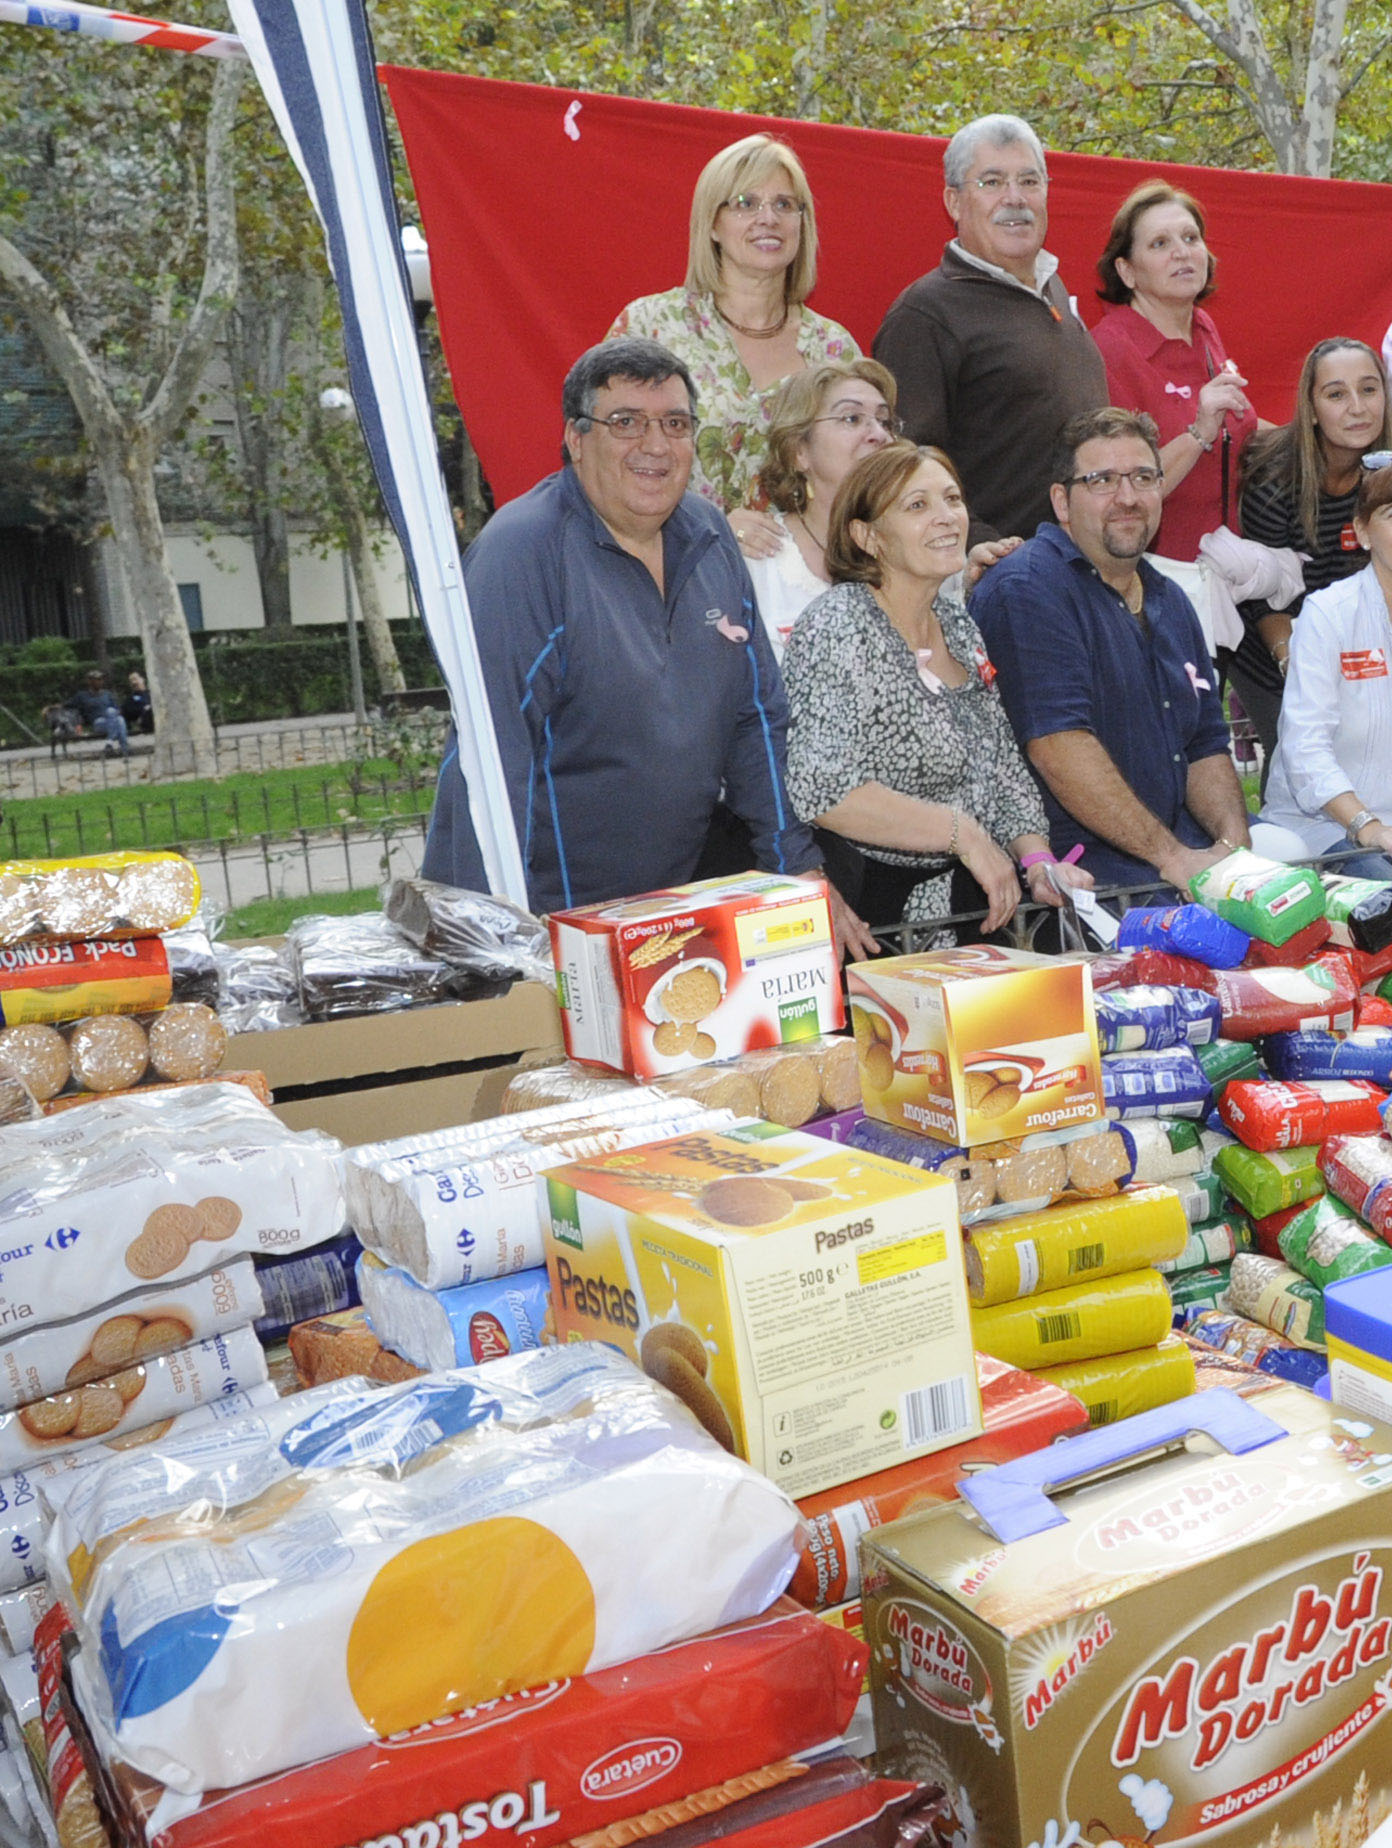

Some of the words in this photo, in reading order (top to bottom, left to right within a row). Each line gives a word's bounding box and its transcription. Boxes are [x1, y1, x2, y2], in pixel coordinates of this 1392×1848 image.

[0, 942, 75, 973] ECONÓ
[84, 939, 138, 962] Pack
[761, 966, 829, 1003] María
[779, 998, 818, 1022] gullón
[902, 1103, 958, 1138] Carrefour
[1026, 1103, 1098, 1127] Carrefour
[658, 1136, 781, 1175] Pastas
[553, 1218, 583, 1243] gullón
[815, 1217, 875, 1255] Pastas
[0, 1243, 34, 1264] our
[641, 1239, 668, 1259] RECETA
[668, 1250, 714, 1278] TRADICIONAL
[557, 1256, 641, 1332] Pastas
[799, 1268, 824, 1288] 500
[0, 1302, 34, 1327] ría
[1098, 1464, 1243, 1550] Marbú
[1155, 1480, 1268, 1543] Dorada
[816, 1513, 834, 1547] Peso
[958, 1543, 1008, 1596] Marbú
[888, 1603, 968, 1669] Marbú
[911, 1649, 974, 1695] Dorada
[1022, 1613, 1115, 1730] Marbú
[1110, 1551, 1385, 1769] Marbú
[1189, 1617, 1392, 1772] Dorada
[585, 1744, 677, 1792] Cuétara
[1199, 1775, 1278, 1826] Sabrosa
[1290, 1704, 1375, 1779] crujiente
[350, 1779, 561, 1848] Tosta
